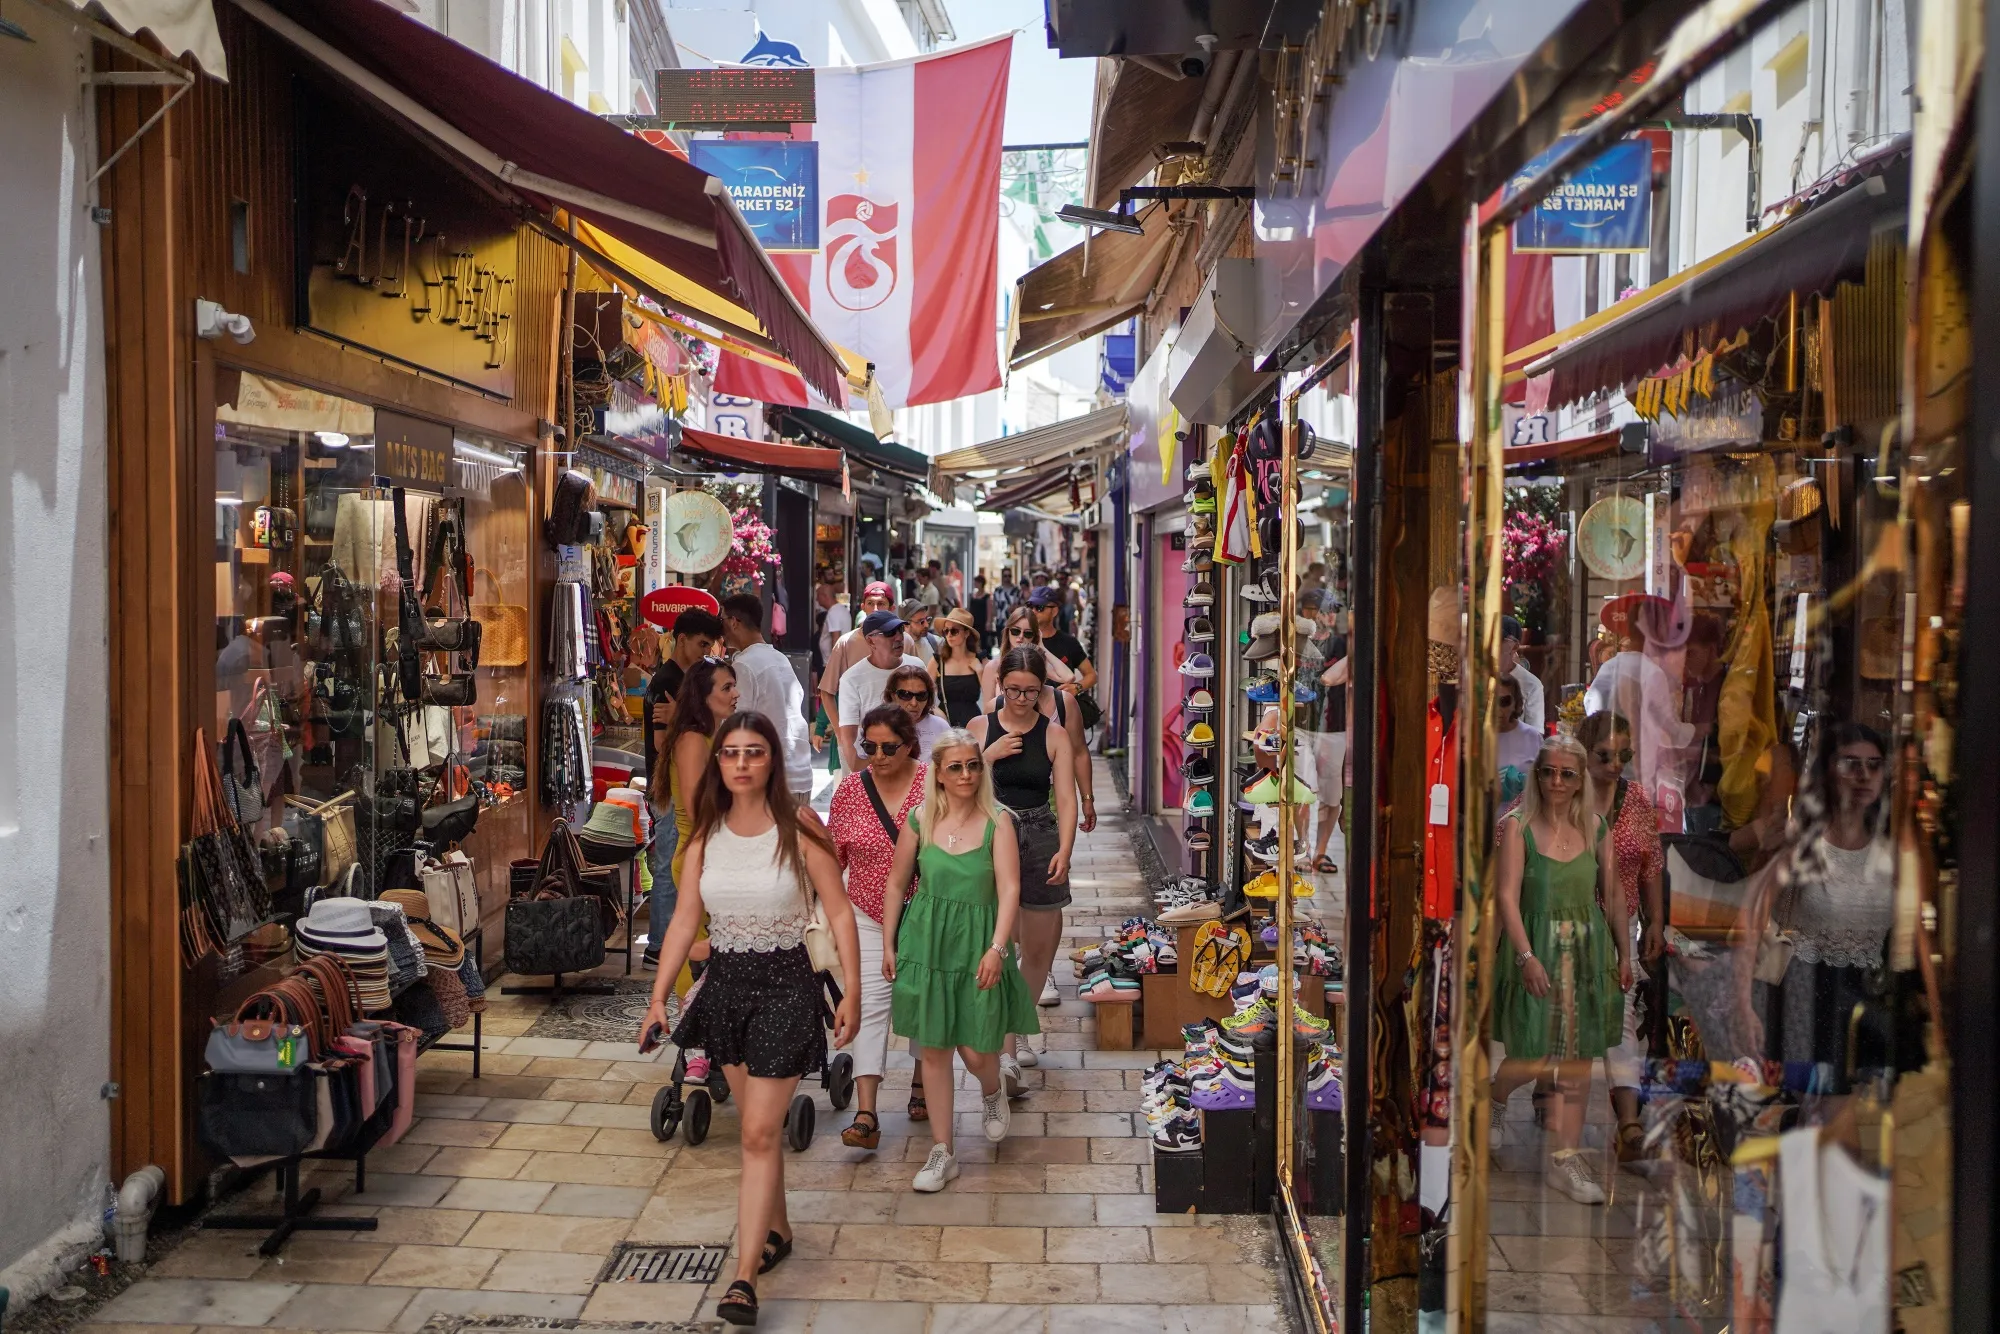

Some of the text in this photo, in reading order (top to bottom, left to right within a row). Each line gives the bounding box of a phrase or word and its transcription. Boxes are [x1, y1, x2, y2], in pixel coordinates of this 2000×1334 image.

[725, 183, 805, 197] KARADENİZ
[735, 199, 794, 211] RKET 52
[420, 448, 446, 483] BAG
[651, 600, 708, 613] havaias
